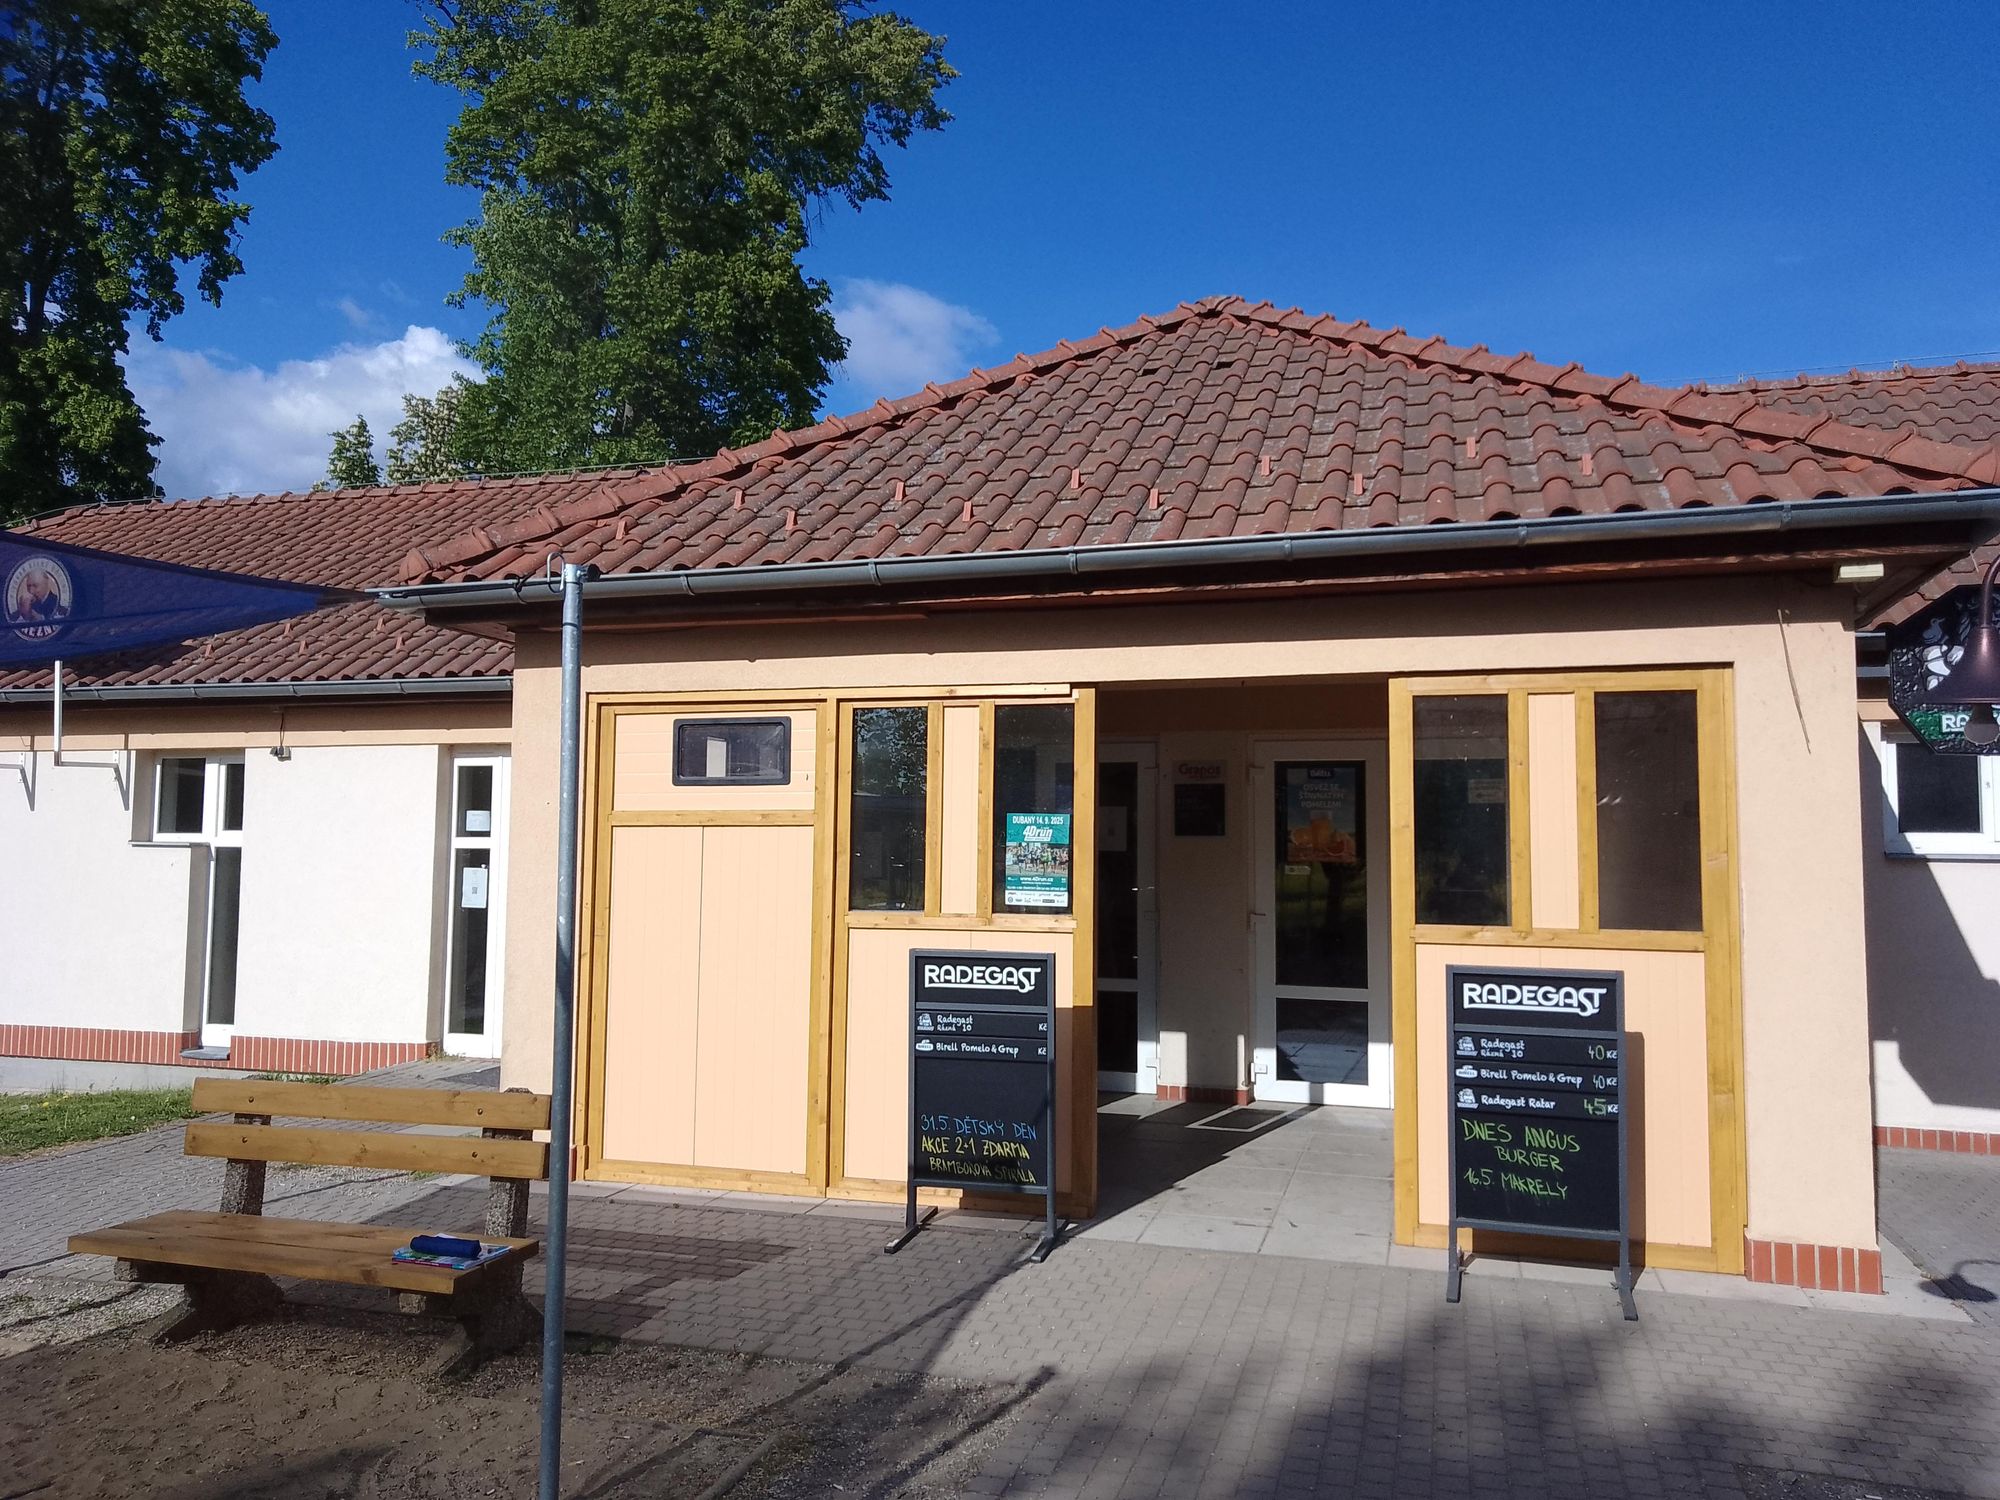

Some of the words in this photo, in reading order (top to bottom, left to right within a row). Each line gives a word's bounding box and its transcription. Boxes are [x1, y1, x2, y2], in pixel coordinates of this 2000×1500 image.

[1050, 816, 1064, 825] 2025
[924, 964, 1042, 993] RADEGAST
[1463, 982, 1607, 1017] RADEGAST
[937, 1014, 973, 1026] Radegast
[1038, 1023, 1047, 1031] Kč
[936, 1042, 958, 1051] Birell
[961, 1042, 990, 1053] Pomelo
[991, 1044, 997, 1054] &
[998, 1044, 1019, 1058] Grep
[1037, 1047, 1047, 1055] Kč
[1480, 1038, 1525, 1053] Radegast
[1511, 1049, 1524, 1058] 10
[1588, 1044, 1605, 1060] 40
[1606, 1050, 1618, 1059] Kč
[1480, 1069, 1508, 1080] Birell
[1511, 1070, 1548, 1082] Pomelo
[1548, 1072, 1556, 1082] &
[1557, 1073, 1583, 1089] Grep
[1592, 1074, 1606, 1090] 40
[1606, 1077, 1618, 1087] Kč
[1480, 1094, 1526, 1109] Radegast
[1529, 1097, 1556, 1110] Ratar
[1583, 1098, 1607, 1117] 45
[1607, 1104, 1619, 1114] Kč
[921, 1114, 951, 1131] 31.5.
[1012, 1122, 1037, 1140] DEN
[1461, 1118, 1513, 1143] DNES
[1525, 1125, 1581, 1152] ANGUS
[921, 1135, 950, 1154] AKCE
[955, 1136, 976, 1155] 2+1
[982, 1139, 1030, 1160] ZDARMA
[1494, 1145, 1564, 1172] BURGER
[1501, 1172, 1568, 1200] MAKRELY
